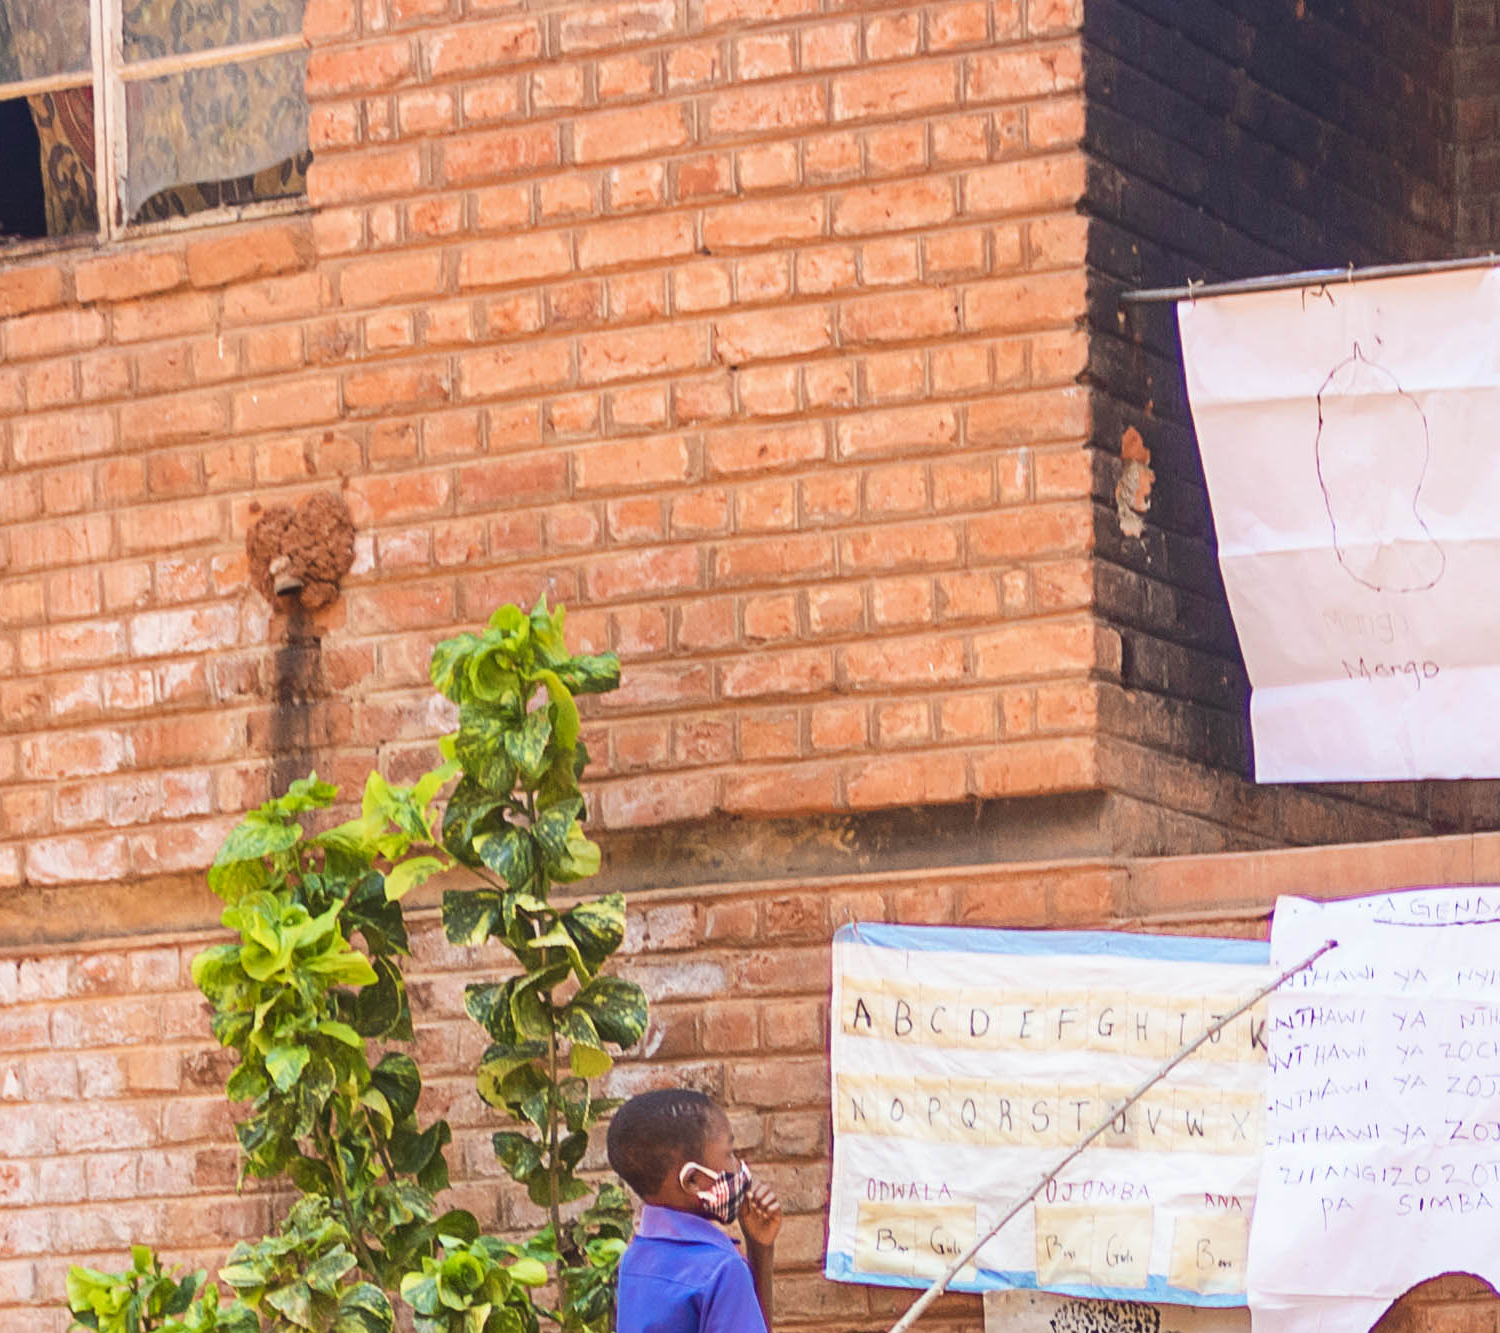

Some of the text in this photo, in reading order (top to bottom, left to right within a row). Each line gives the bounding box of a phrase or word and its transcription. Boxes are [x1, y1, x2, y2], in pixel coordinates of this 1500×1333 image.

[1341, 656, 1440, 692] Mango
[1393, 968, 1428, 991] YA
[853, 997, 872, 1029] A
[894, 999, 913, 1037] B
[930, 1005, 947, 1035] C
[969, 1008, 990, 1038] D
[1019, 1008, 1035, 1040] E
[1057, 1007, 1078, 1041] F
[1097, 1007, 1115, 1037] G
[1136, 1012, 1149, 1041] H
[1179, 1013, 1187, 1047] I
[1250, 1016, 1269, 1053] K
[1392, 1009, 1428, 1032] YA
[1396, 1044, 1425, 1061] YA
[1393, 1074, 1428, 1095] YA
[851, 1097, 866, 1122] N
[890, 1097, 905, 1122] O
[927, 1096, 942, 1127] P
[961, 1097, 977, 1130] Q
[999, 1098, 1013, 1132] R
[1031, 1100, 1050, 1133] S
[1069, 1100, 1090, 1132] T
[1147, 1108, 1162, 1135] V
[1185, 1109, 1206, 1137] W
[1232, 1111, 1250, 1142] X
[1393, 1123, 1427, 1145] YA
[867, 1177, 952, 1201] ODWALA
[1396, 1193, 1493, 1217] SIMBA
